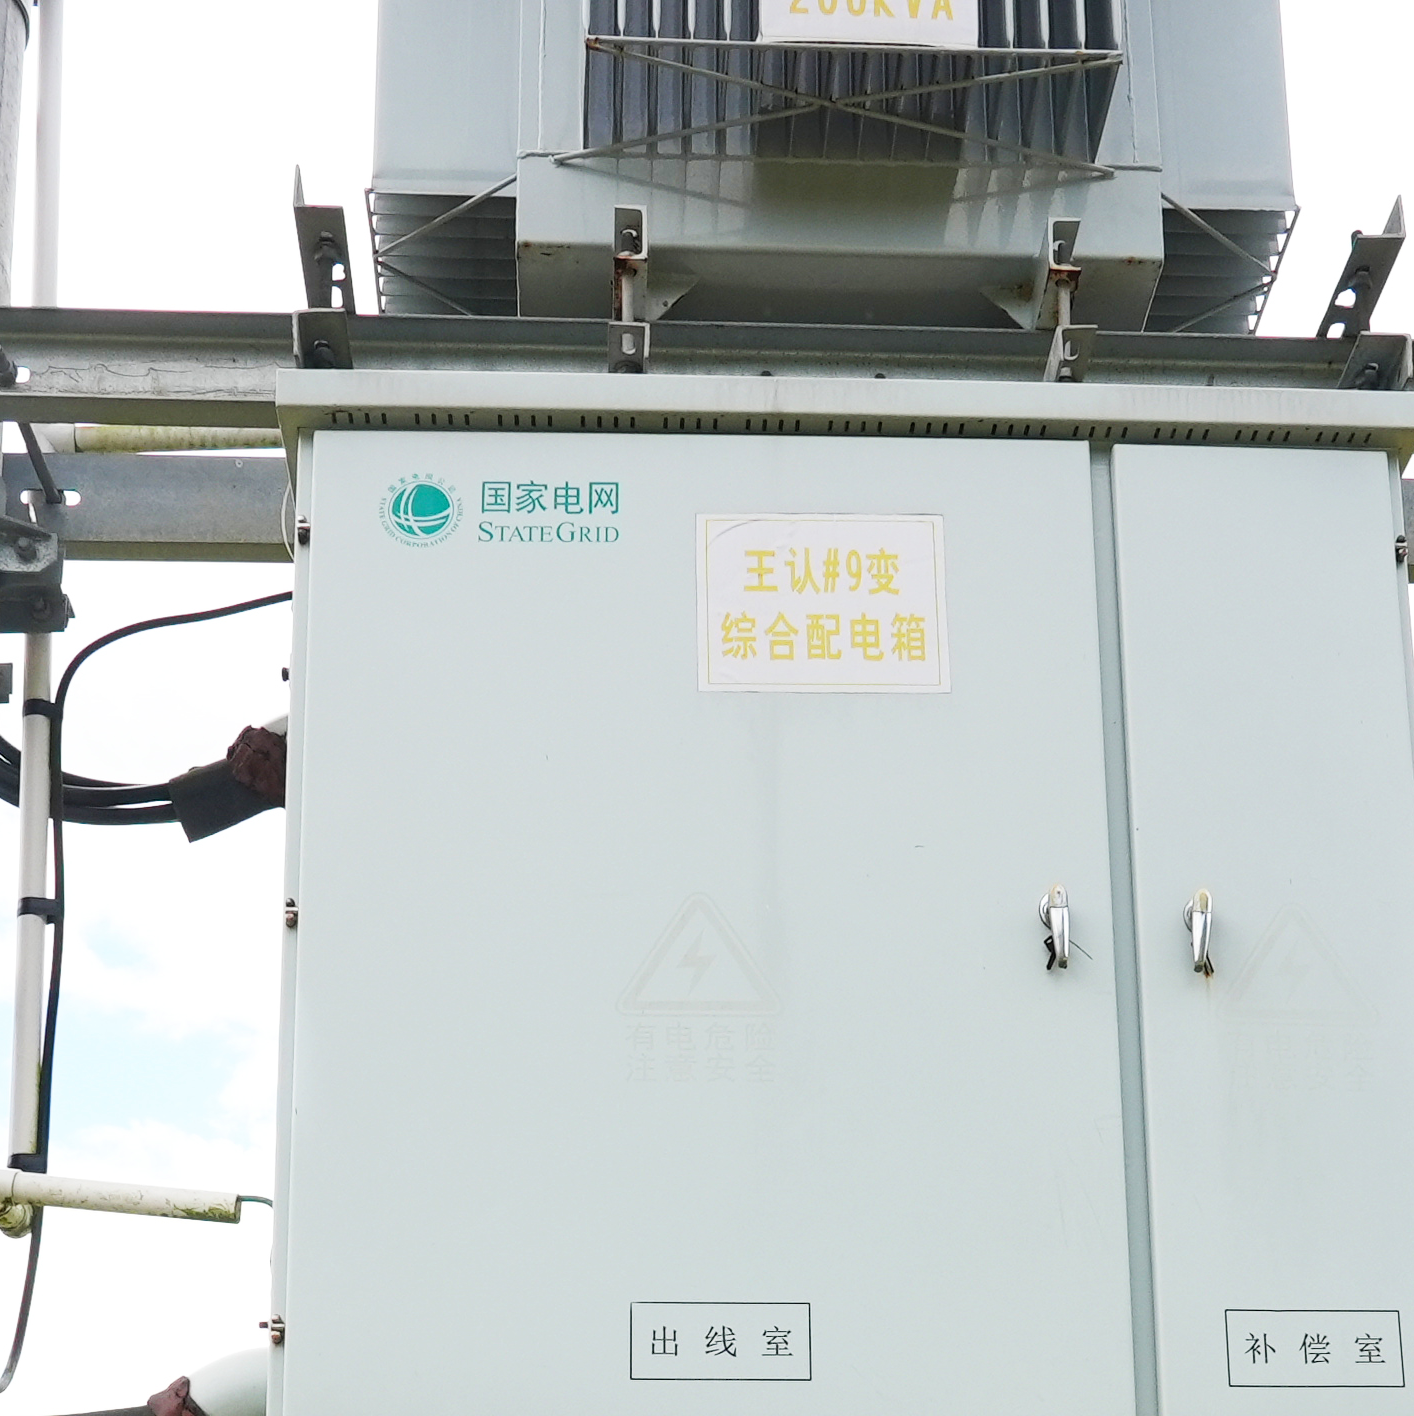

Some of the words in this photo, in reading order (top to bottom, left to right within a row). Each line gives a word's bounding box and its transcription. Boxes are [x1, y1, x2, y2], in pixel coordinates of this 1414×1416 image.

[480, 480, 620, 515] 国家电网
[743, 548, 900, 595] 王认#9变
[721, 611, 927, 661] 综合配电箱
[650, 1325, 794, 1358] 出线室
[1244, 1332, 1387, 1365] 补偿室
